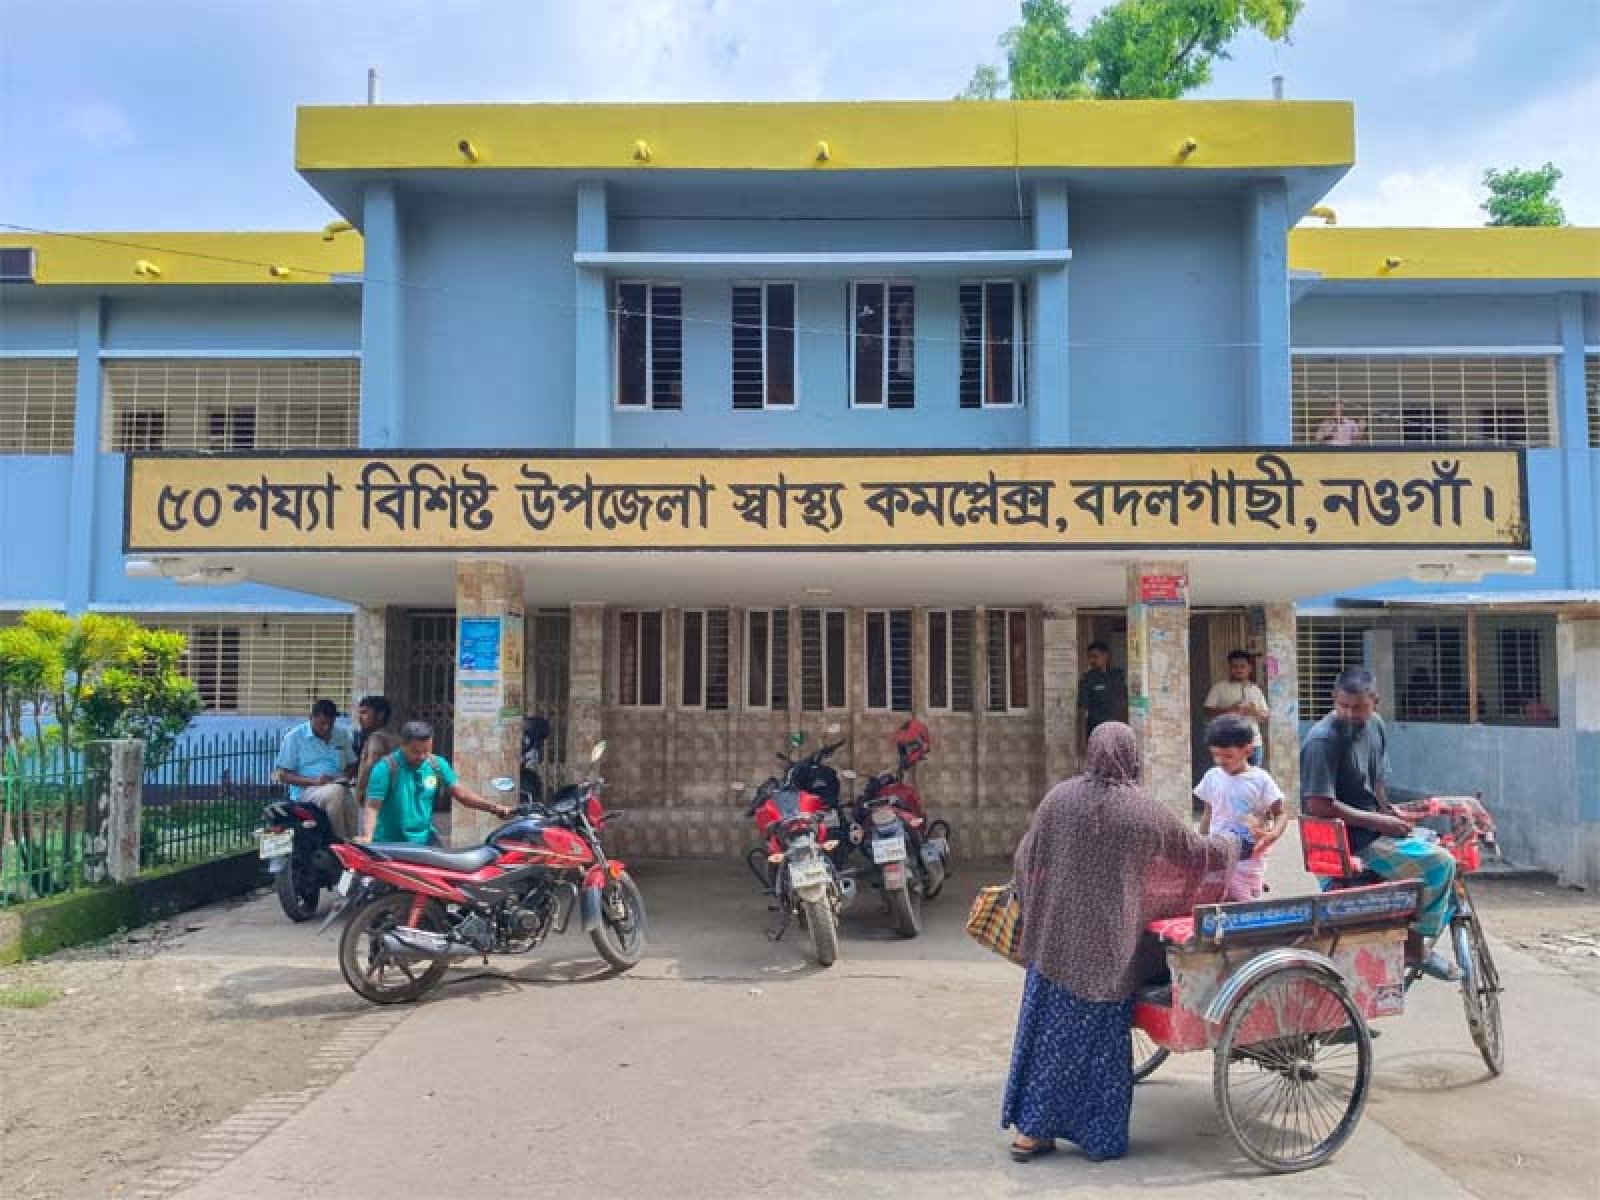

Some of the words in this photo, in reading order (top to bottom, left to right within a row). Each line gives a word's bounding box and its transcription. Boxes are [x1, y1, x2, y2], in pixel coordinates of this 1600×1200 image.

[355, 460, 499, 531] বিশিষ্ট
[515, 464, 716, 531] উপজেলা
[729, 472, 845, 533] স্বাস্থ্য
